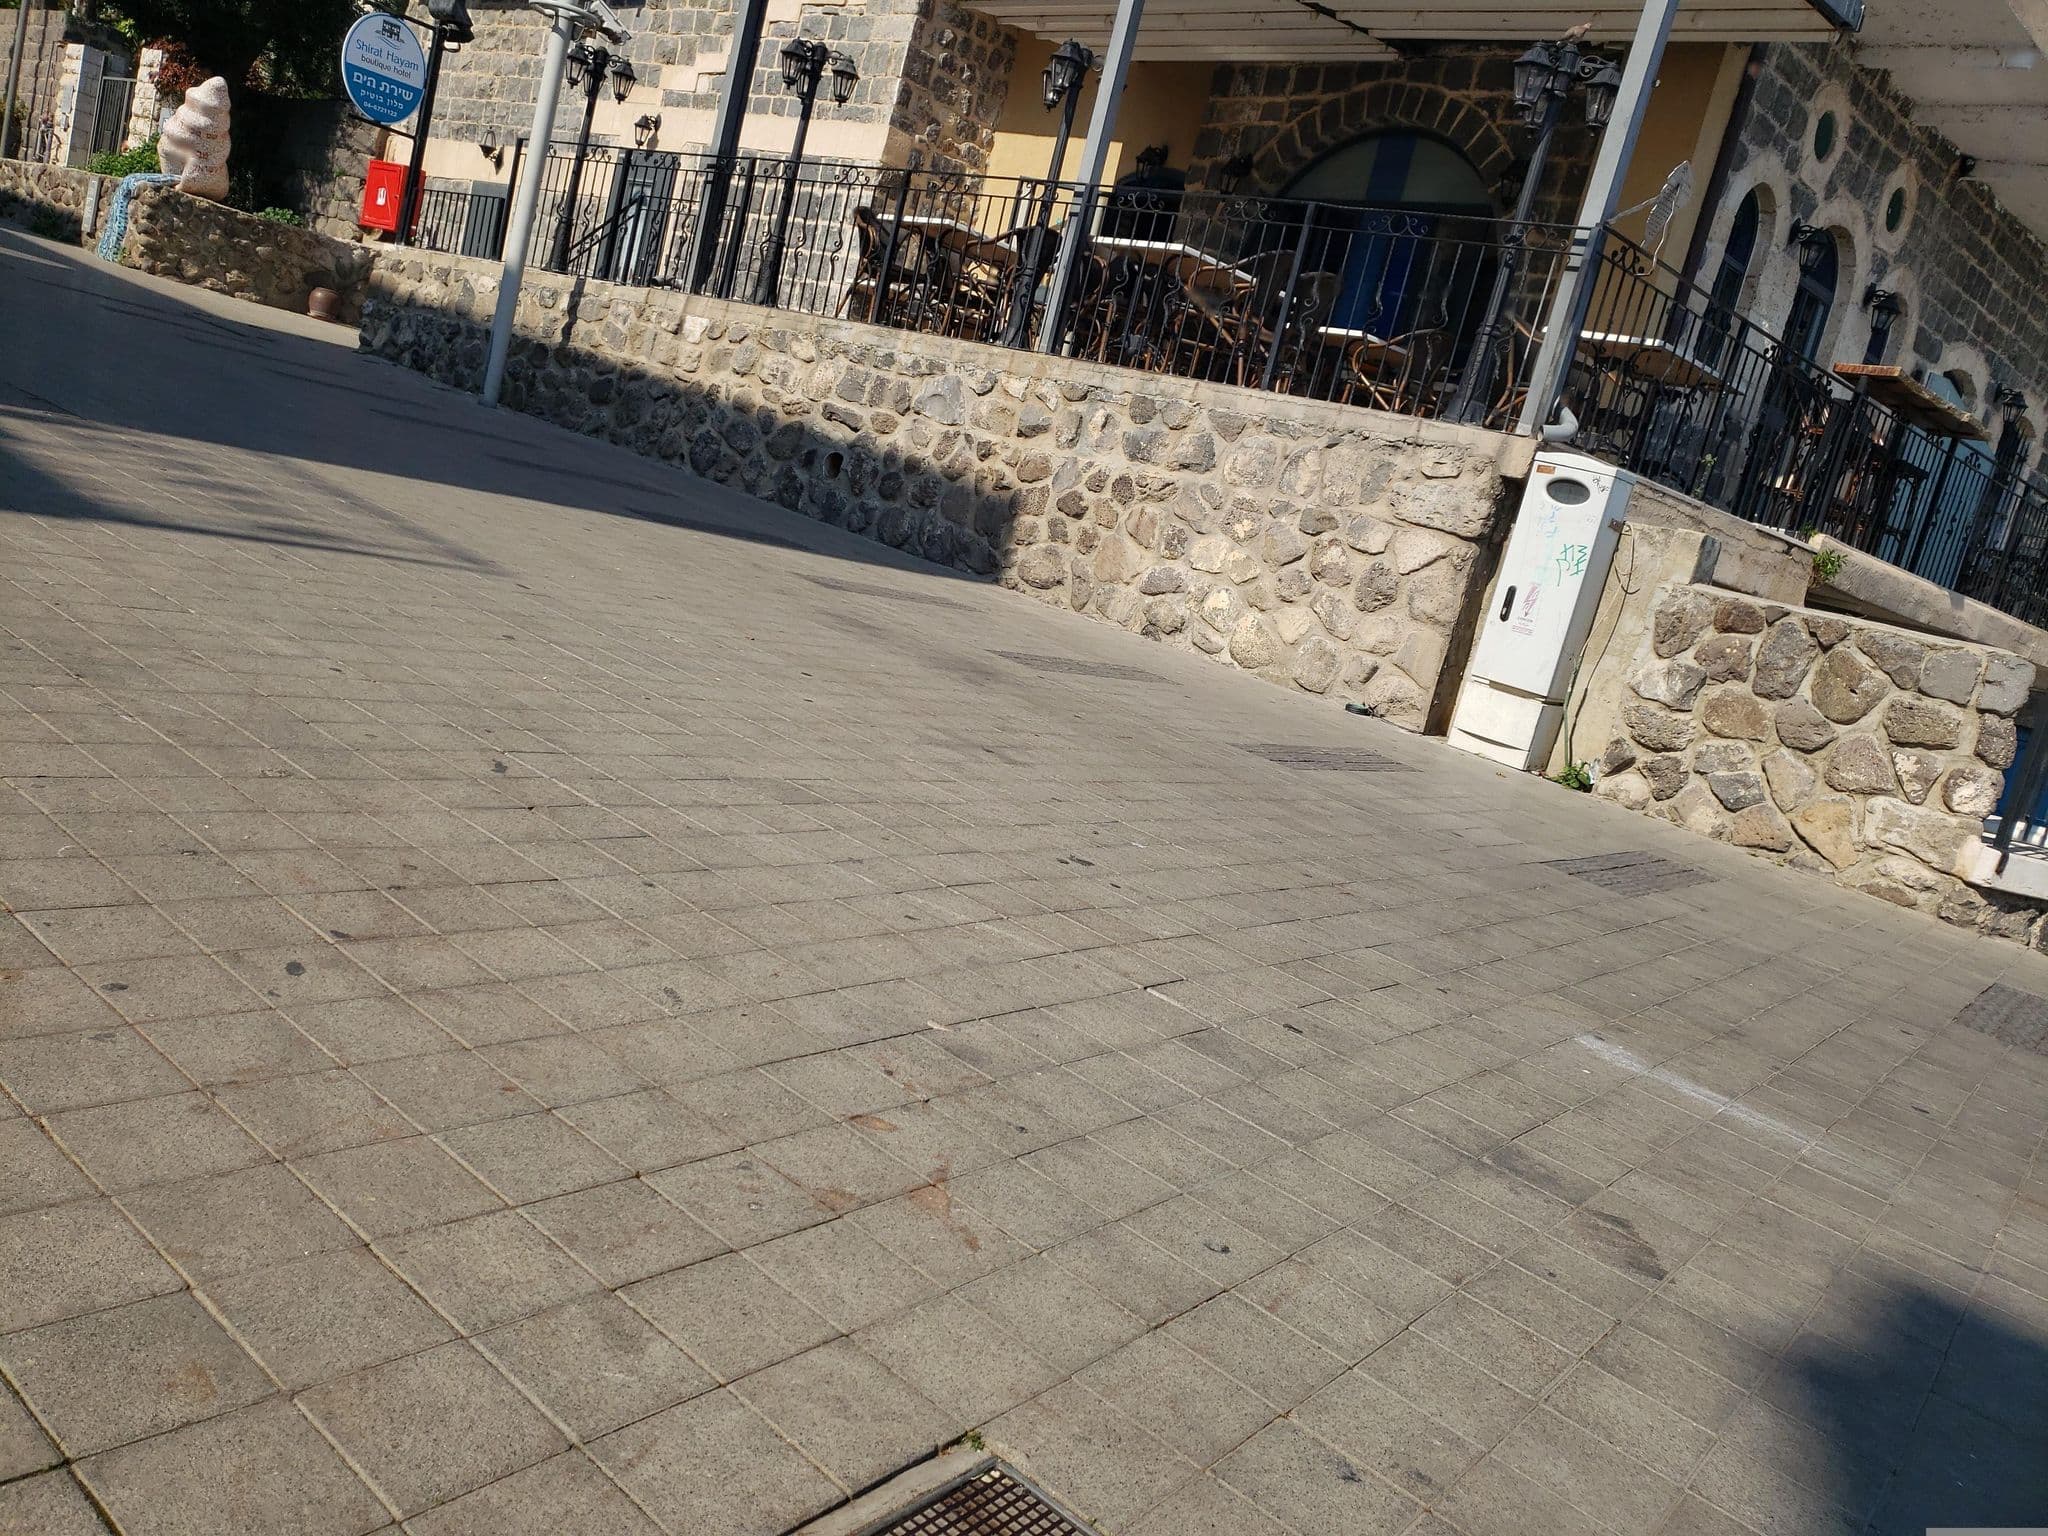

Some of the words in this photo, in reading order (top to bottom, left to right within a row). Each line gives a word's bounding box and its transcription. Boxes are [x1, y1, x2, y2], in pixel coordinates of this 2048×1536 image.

[356, 39, 383, 58] Shirat
[387, 49, 419, 71] Hayam
[361, 54, 392, 72] boutique
[393, 65, 412, 79] hotel
[352, 71, 377, 89] הים
[360, 89, 384, 103] בוטיק
[379, 81, 414, 101] שירת
[386, 97, 404, 110] מלון
